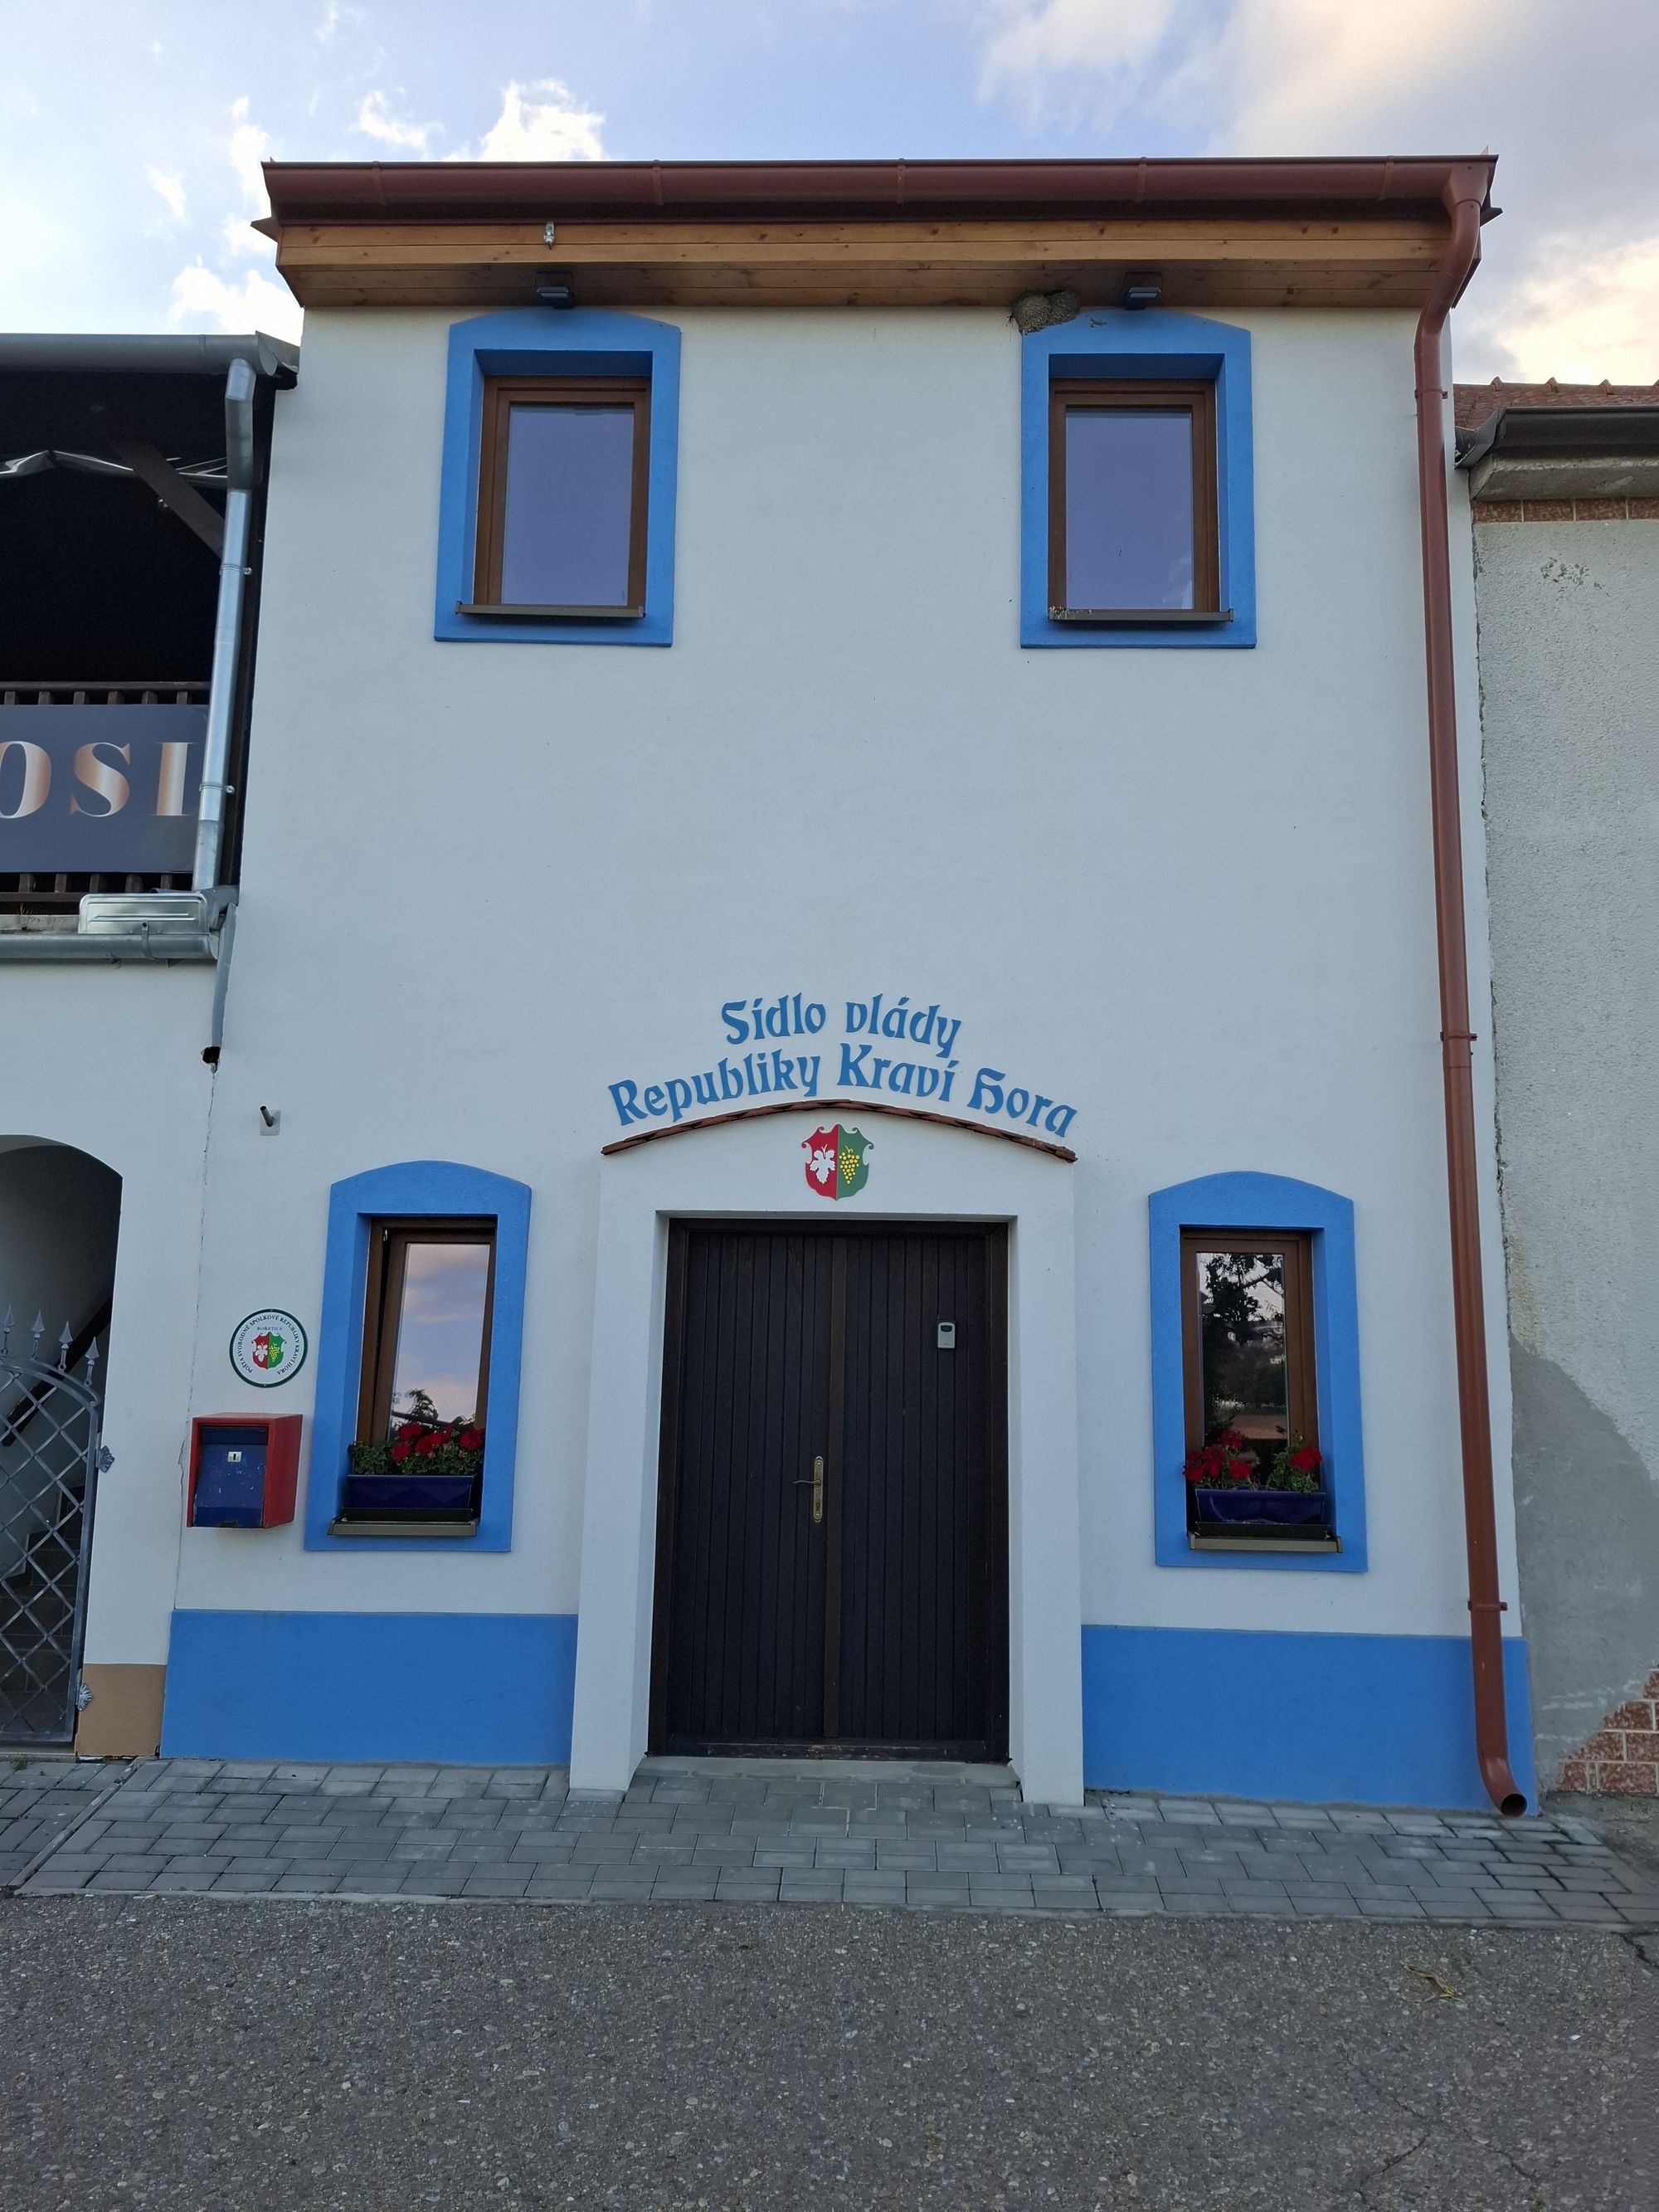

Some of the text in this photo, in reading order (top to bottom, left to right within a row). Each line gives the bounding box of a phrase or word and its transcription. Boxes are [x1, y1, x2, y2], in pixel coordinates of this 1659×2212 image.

[721, 992, 961, 1058] Sídlo vlády
[608, 1043, 1078, 1138] Republiky Kraví Hora
[237, 1314, 299, 1375] POŠTA SVOBODNÉ SPOLKOVÉ REPUBLIKY KRAVÍ HORA
